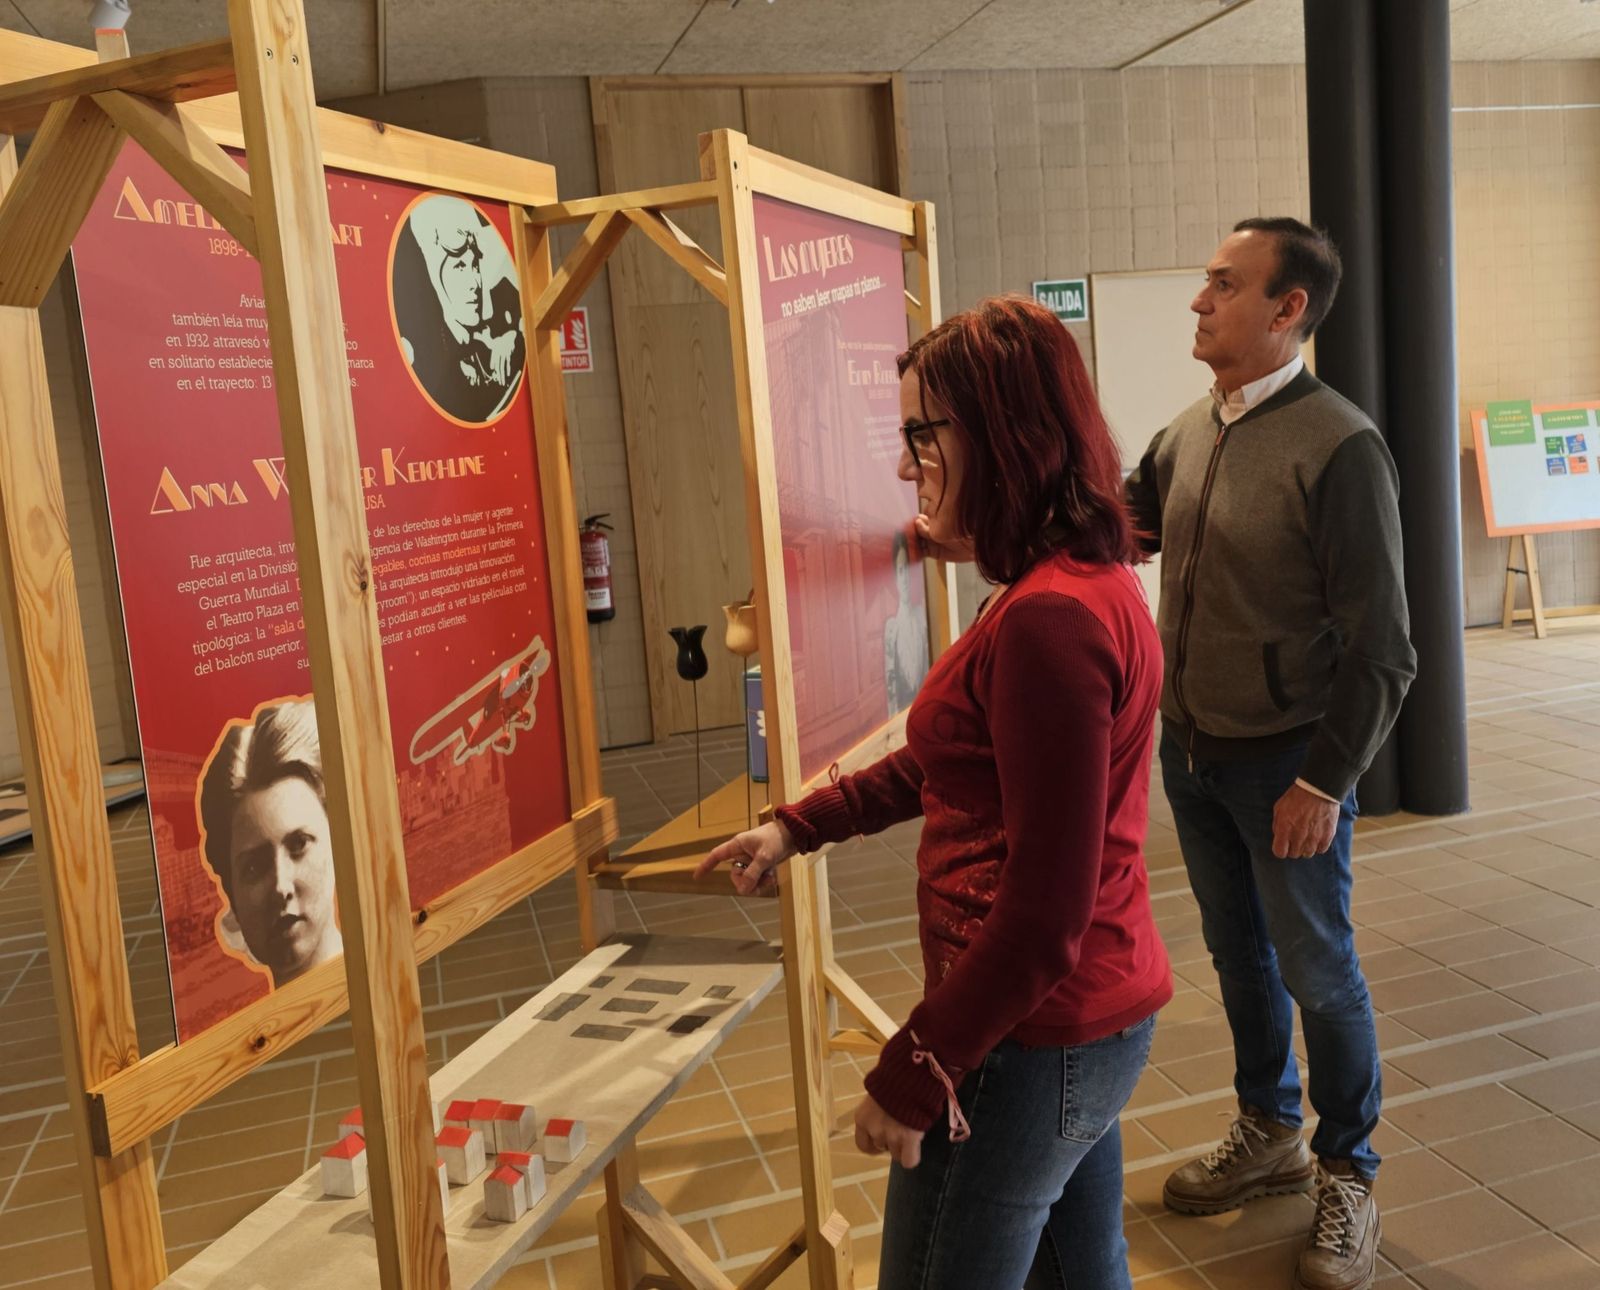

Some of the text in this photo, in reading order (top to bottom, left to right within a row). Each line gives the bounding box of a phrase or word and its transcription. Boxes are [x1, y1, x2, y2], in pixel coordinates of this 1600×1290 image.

[172, 311, 220, 327] también
[223, 313, 243, 328] leía
[780, 300, 793, 319] no
[793, 291, 816, 314] saben
[815, 287, 831, 308] leer
[831, 283, 854, 304] mapas
[853, 276, 861, 296] ni
[1038, 289, 1083, 312] SALIDA
[149, 357, 165, 369] en
[168, 354, 215, 369] solitario
[218, 355, 273, 369] establecie
[166, 336, 182, 347] en
[185, 333, 210, 348] 1932
[213, 335, 261, 349] atravesó
[177, 379, 192, 390] en
[195, 376, 206, 390] el
[150, 466, 249, 515] ANNA
[381, 445, 486, 487] KEICHLINE
[177, 571, 229, 595] especial
[230, 570, 246, 584] en
[246, 567, 258, 581] la
[402, 538, 414, 551] de
[414, 531, 460, 549] Washington
[460, 526, 488, 541] durante
[488, 523, 496, 535] la
[495, 520, 524, 534] Primera
[190, 554, 212, 570] Fue
[215, 546, 276, 567] arquitecta,
[373, 525, 385, 538] de
[386, 523, 401, 536] los
[402, 517, 441, 534] derechos
[441, 514, 452, 527] de
[453, 512, 462, 525] la
[462, 510, 484, 524] mujer
[485, 510, 491, 521] y
[491, 506, 514, 520] agente
[198, 592, 242, 611] Guerra
[408, 552, 441, 568] cocinas
[442, 545, 481, 561] modernas
[481, 543, 488, 555] y
[487, 537, 516, 551] también
[206, 612, 218, 631] el
[219, 609, 254, 628] Teatro
[255, 604, 284, 620] Plaza
[285, 600, 300, 613] en
[379, 578, 388, 592] la
[389, 571, 430, 590] arquitecta
[430, 563, 464, 581] introdujo
[464, 561, 479, 573] una
[479, 553, 516, 569] innovación
[256, 626, 267, 640] la
[418, 589, 430, 601] un
[431, 580, 461, 598] espacio
[461, 574, 491, 590] vidriado
[491, 572, 501, 583] en
[501, 568, 509, 580] el
[508, 564, 525, 578] nivel
[194, 658, 214, 677] del
[215, 650, 255, 672] balcón
[387, 609, 420, 629] podían
[420, 601, 446, 617] acudir
[447, 600, 454, 610] a
[454, 596, 468, 609] ver
[468, 593, 481, 605] las
[481, 584, 514, 604] películas
[514, 582, 528, 593] con
[406, 628, 413, 640] a
[413, 622, 436, 638] otros
